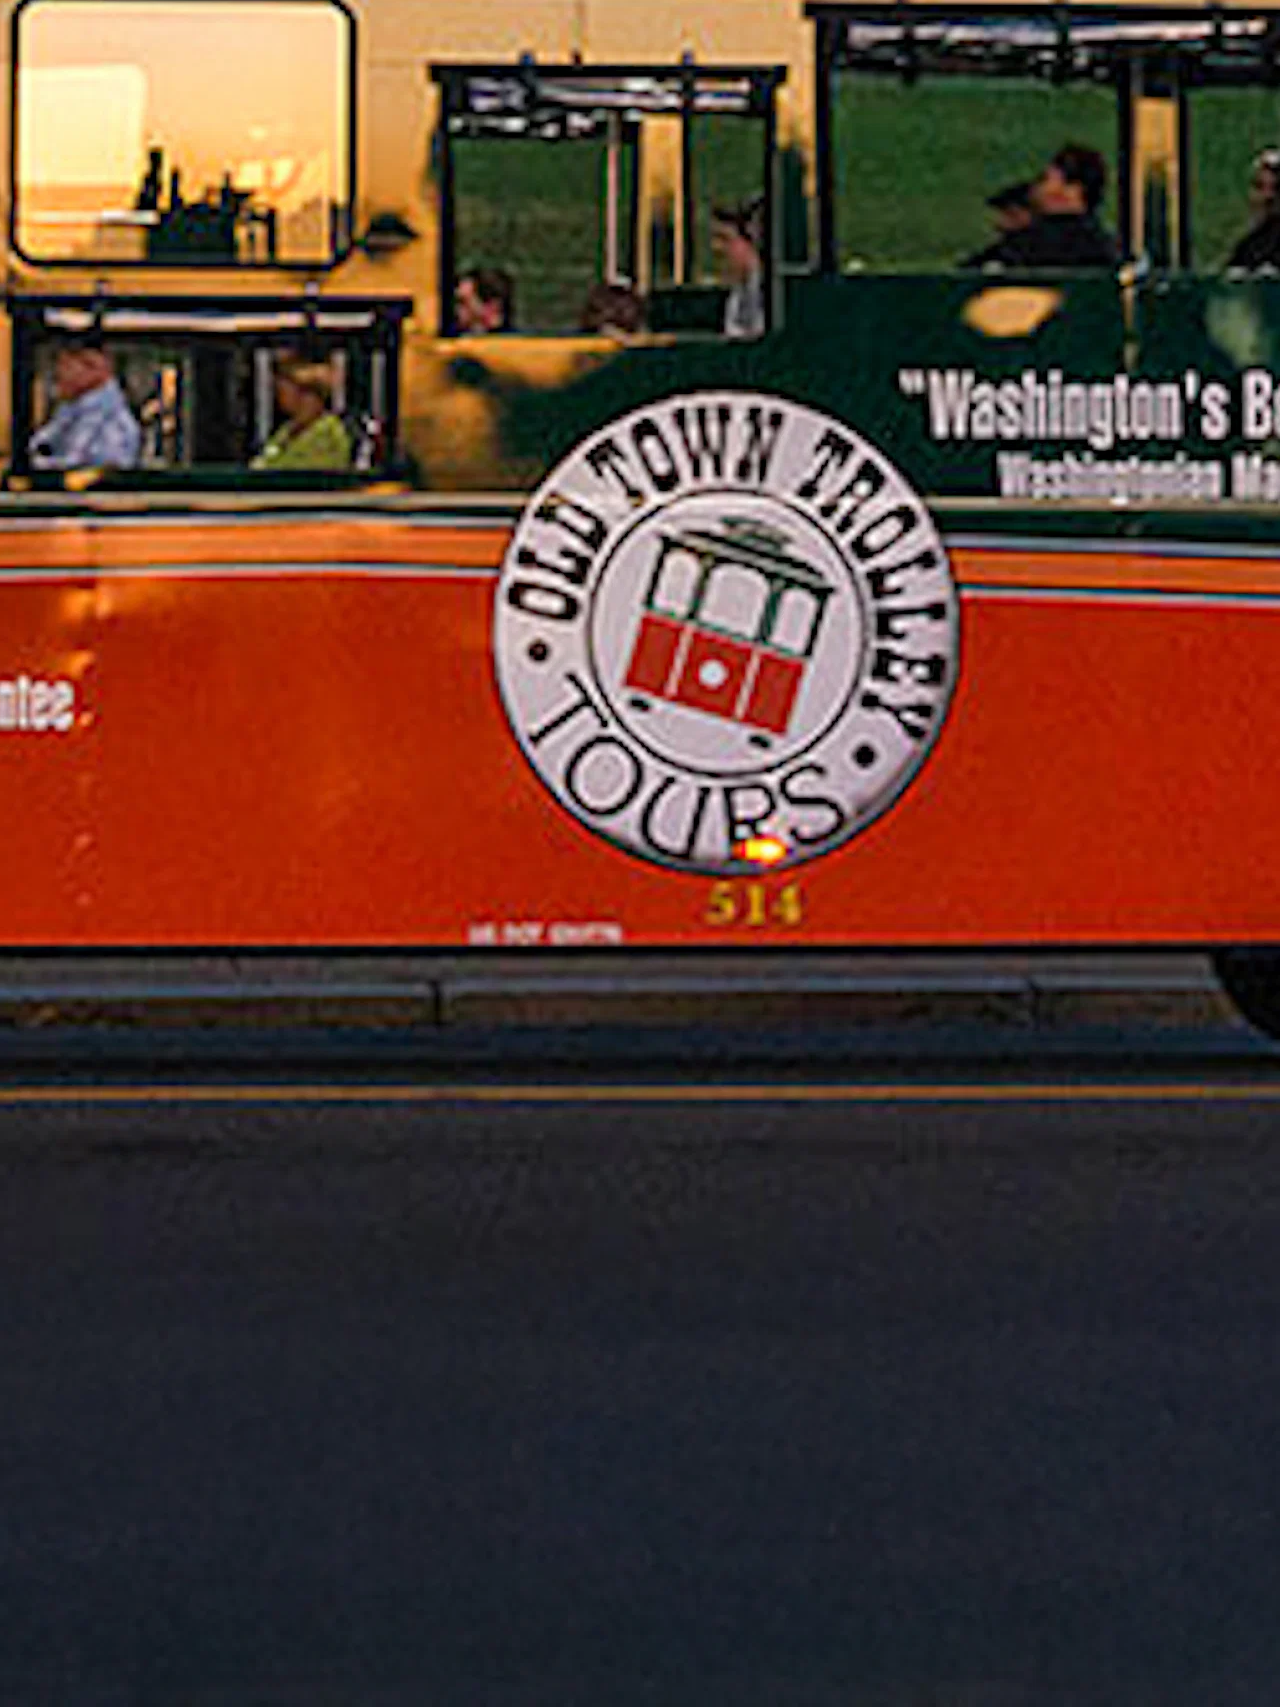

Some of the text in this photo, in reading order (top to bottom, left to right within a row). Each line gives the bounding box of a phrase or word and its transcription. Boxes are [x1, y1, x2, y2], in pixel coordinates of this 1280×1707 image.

[506, 405, 949, 741] OLD TOWN TROLLEY
[527, 671, 846, 861] TOURS
[704, 880, 803, 927] 514
